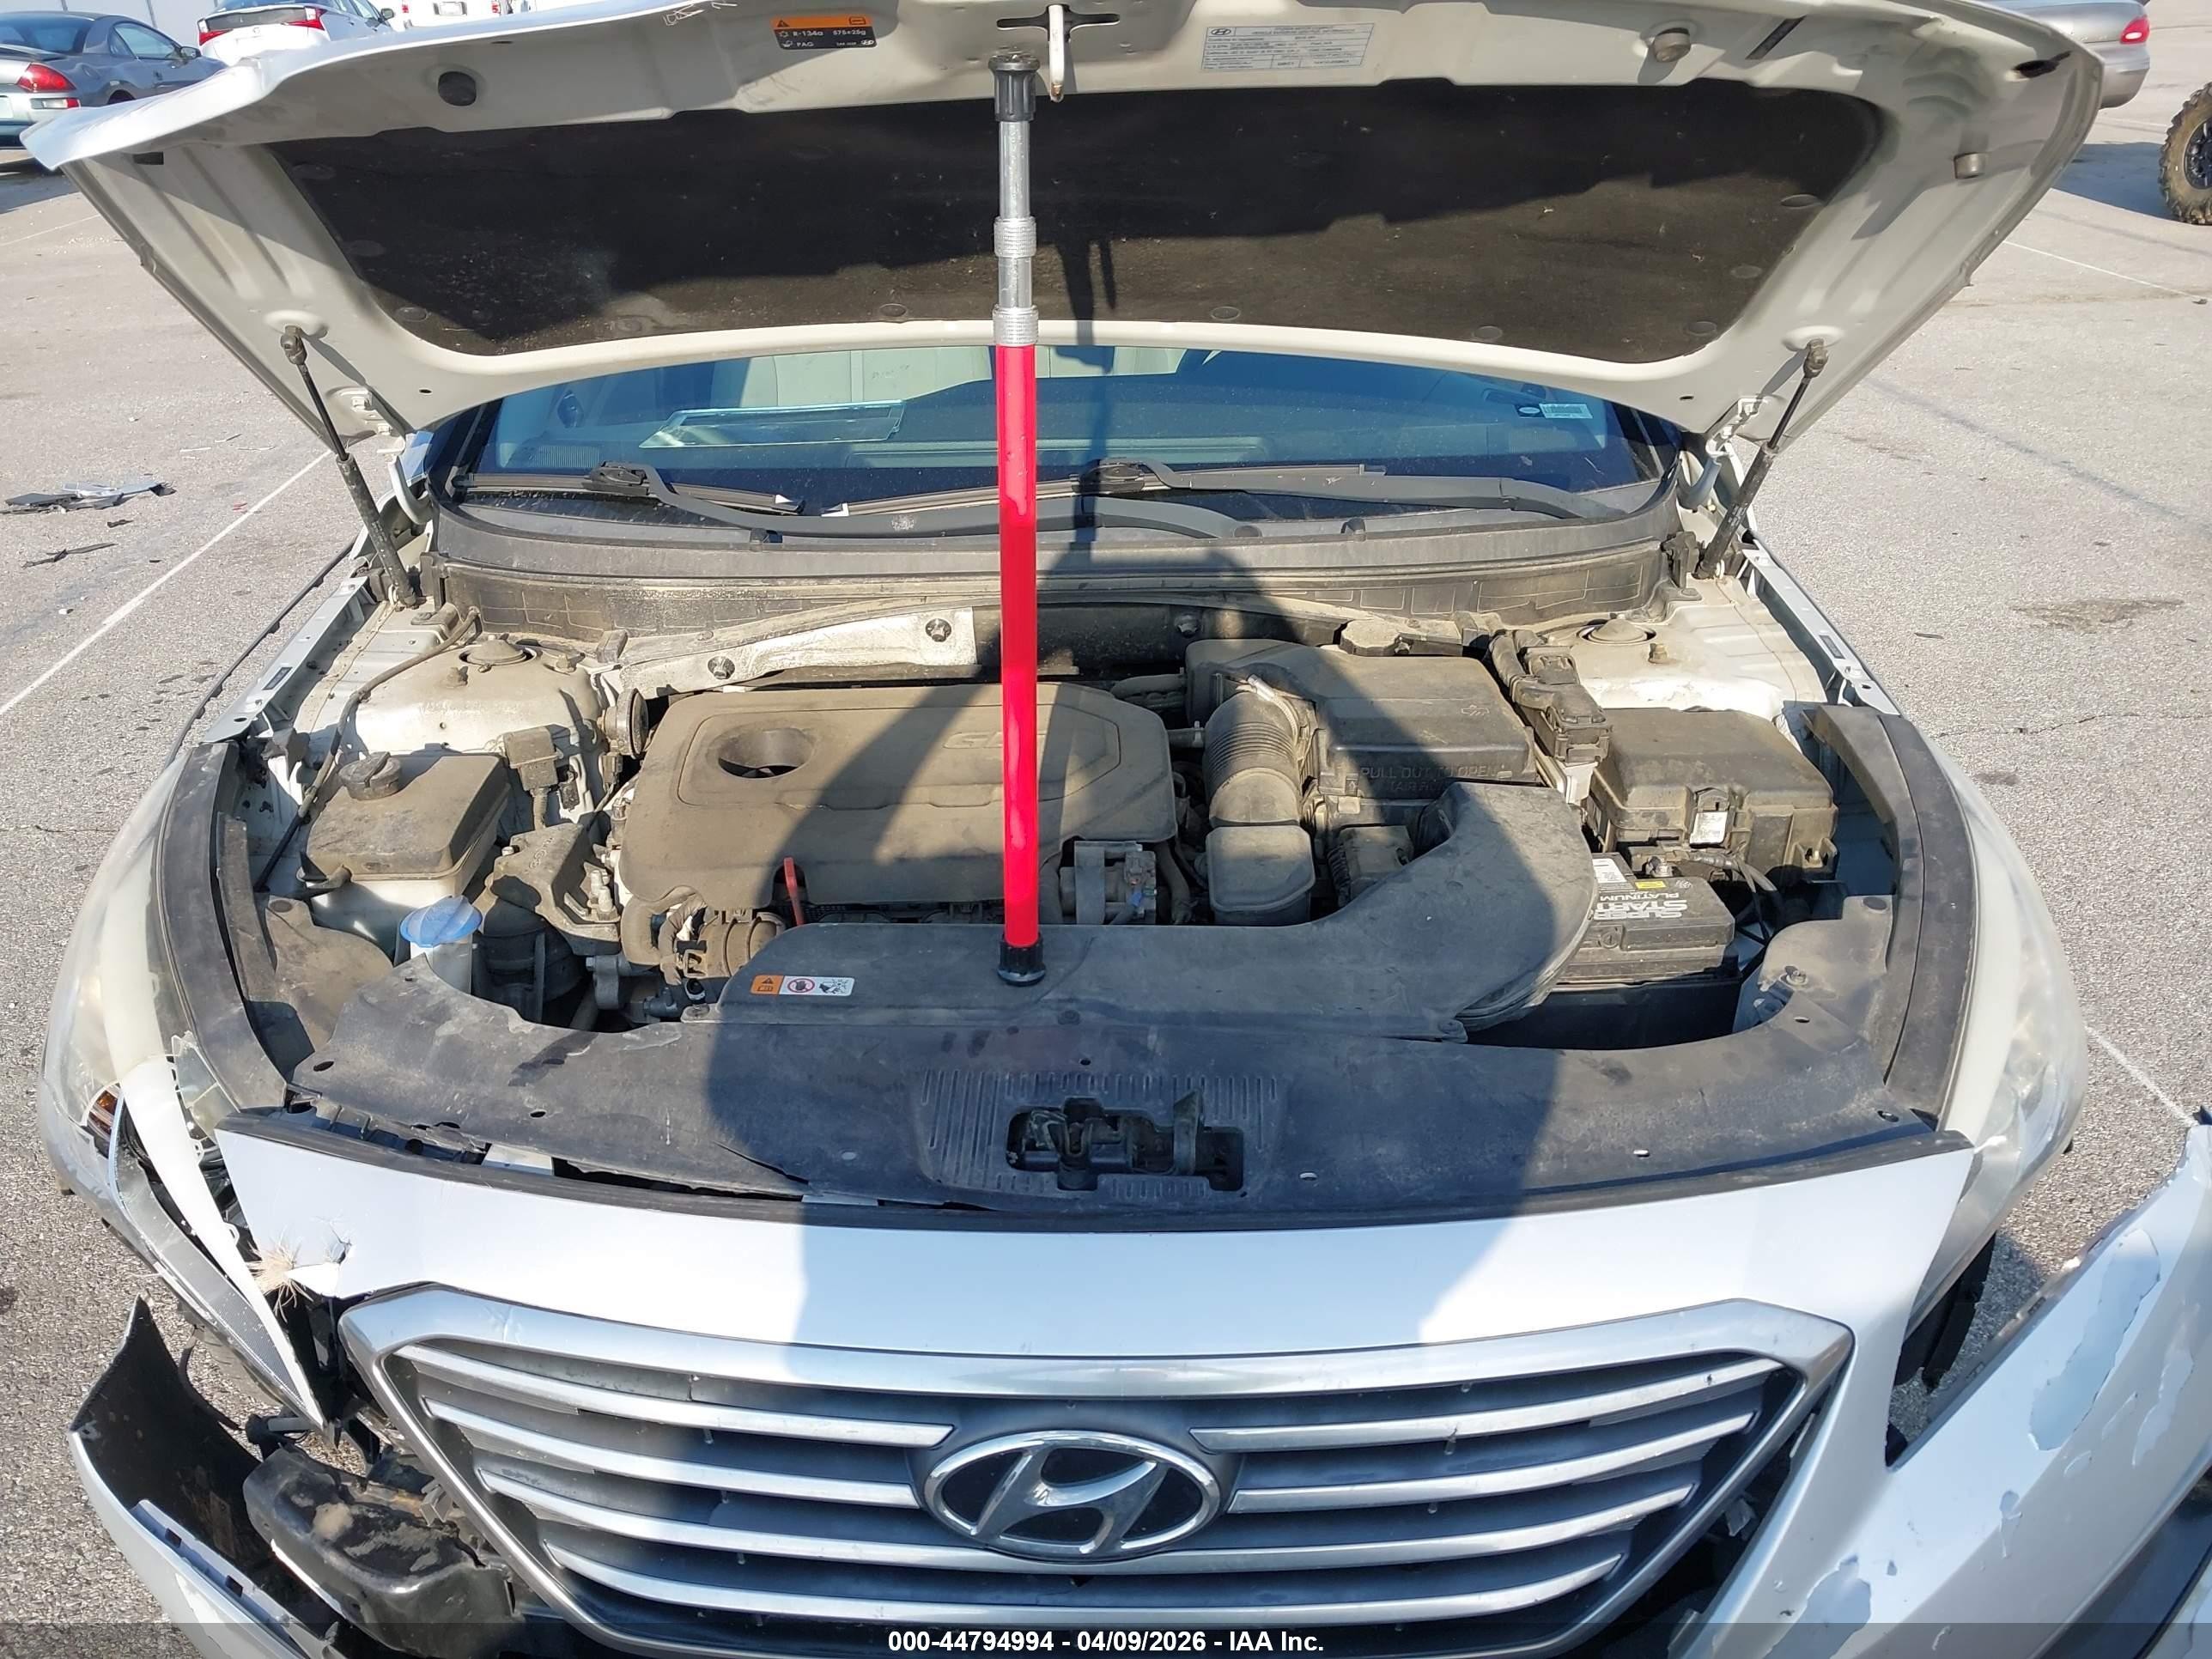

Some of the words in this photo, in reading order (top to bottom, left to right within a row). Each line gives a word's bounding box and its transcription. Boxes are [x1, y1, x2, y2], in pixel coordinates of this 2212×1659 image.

[1360, 766, 1398, 779] PULL
[1599, 891, 1680, 902] PLATINUM
[1595, 899, 1688, 912] START
[1593, 909, 1683, 921] SUPER
